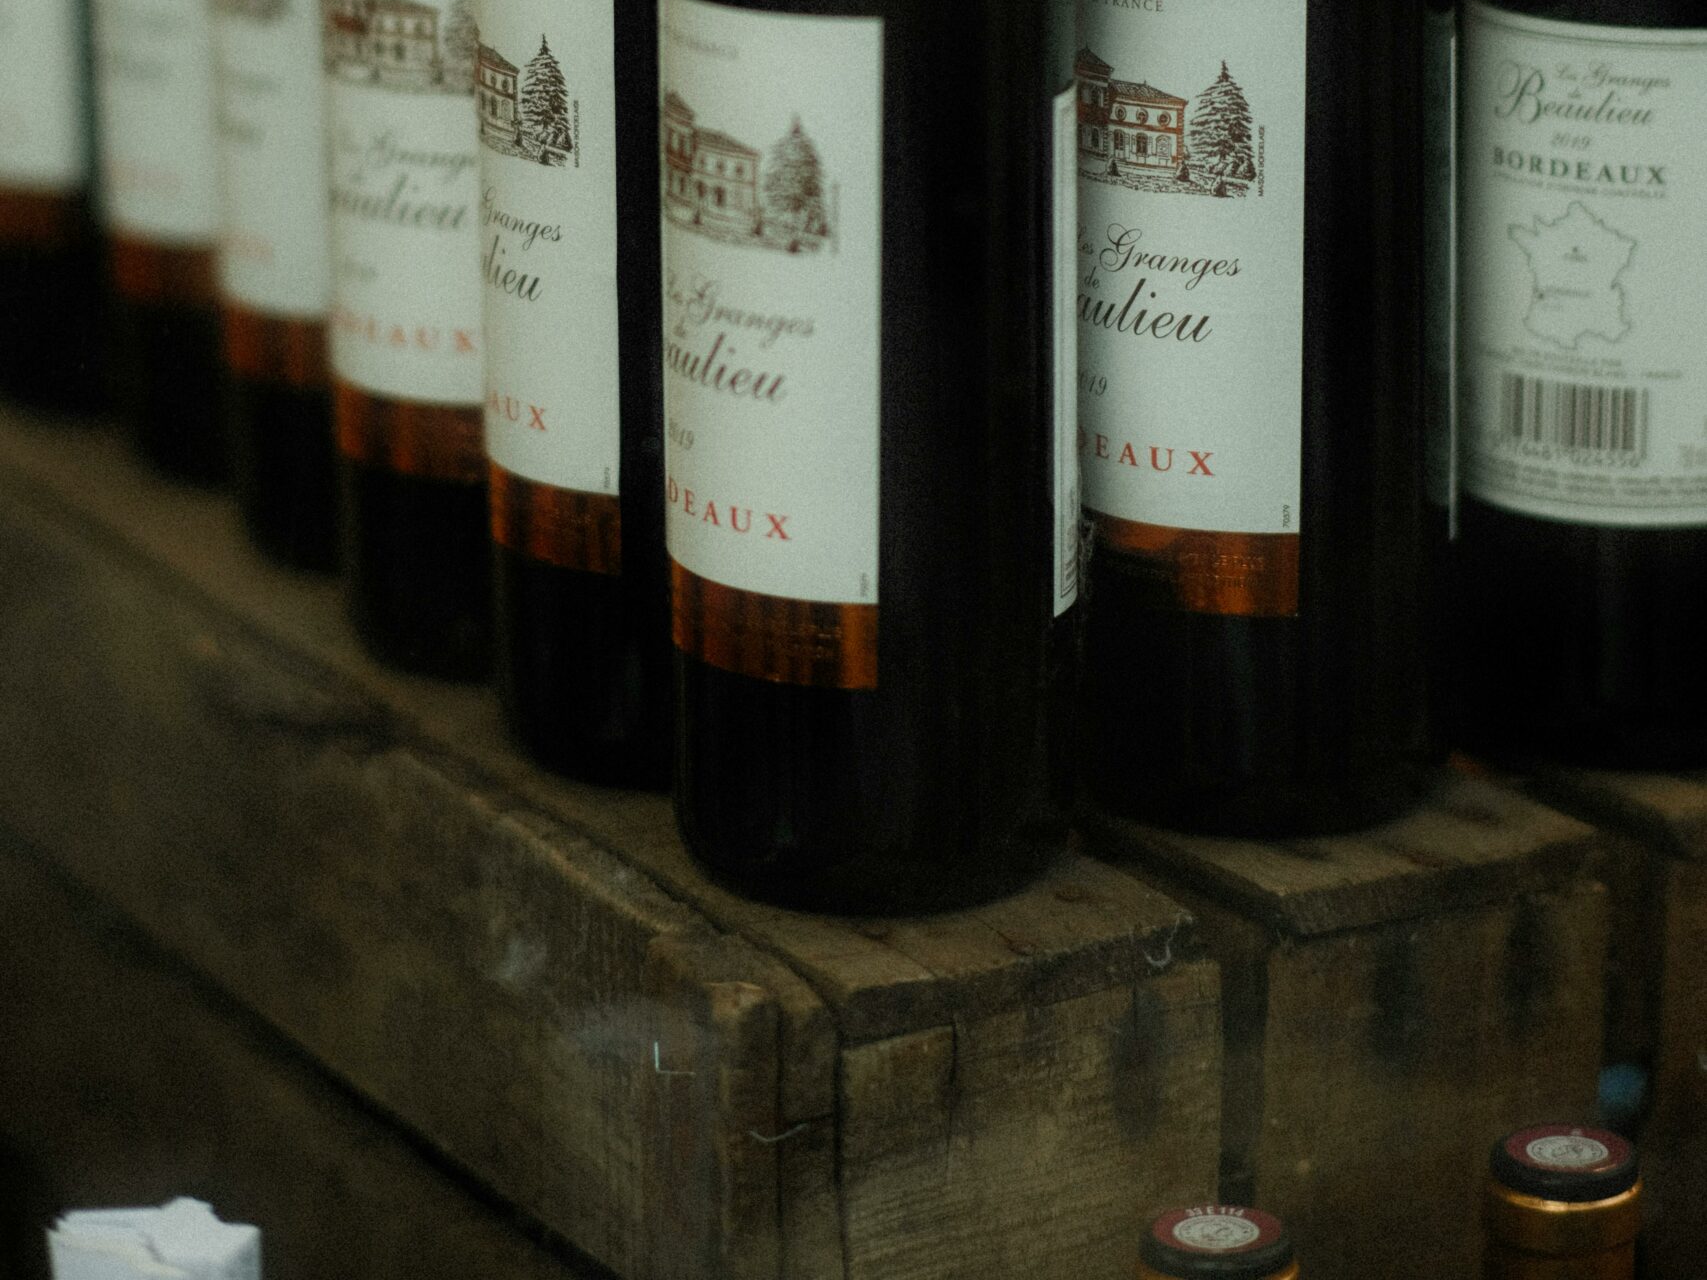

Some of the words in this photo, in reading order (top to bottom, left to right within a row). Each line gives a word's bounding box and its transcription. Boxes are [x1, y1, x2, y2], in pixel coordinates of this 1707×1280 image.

[1495, 59, 1653, 125] Beaulieu
[1257, 168, 1265, 198] MAISON
[1493, 146, 1667, 186] BORDEAUX
[1084, 265, 1100, 290] de
[1099, 222, 1243, 291] Granges
[667, 474, 793, 541] DEAUX
